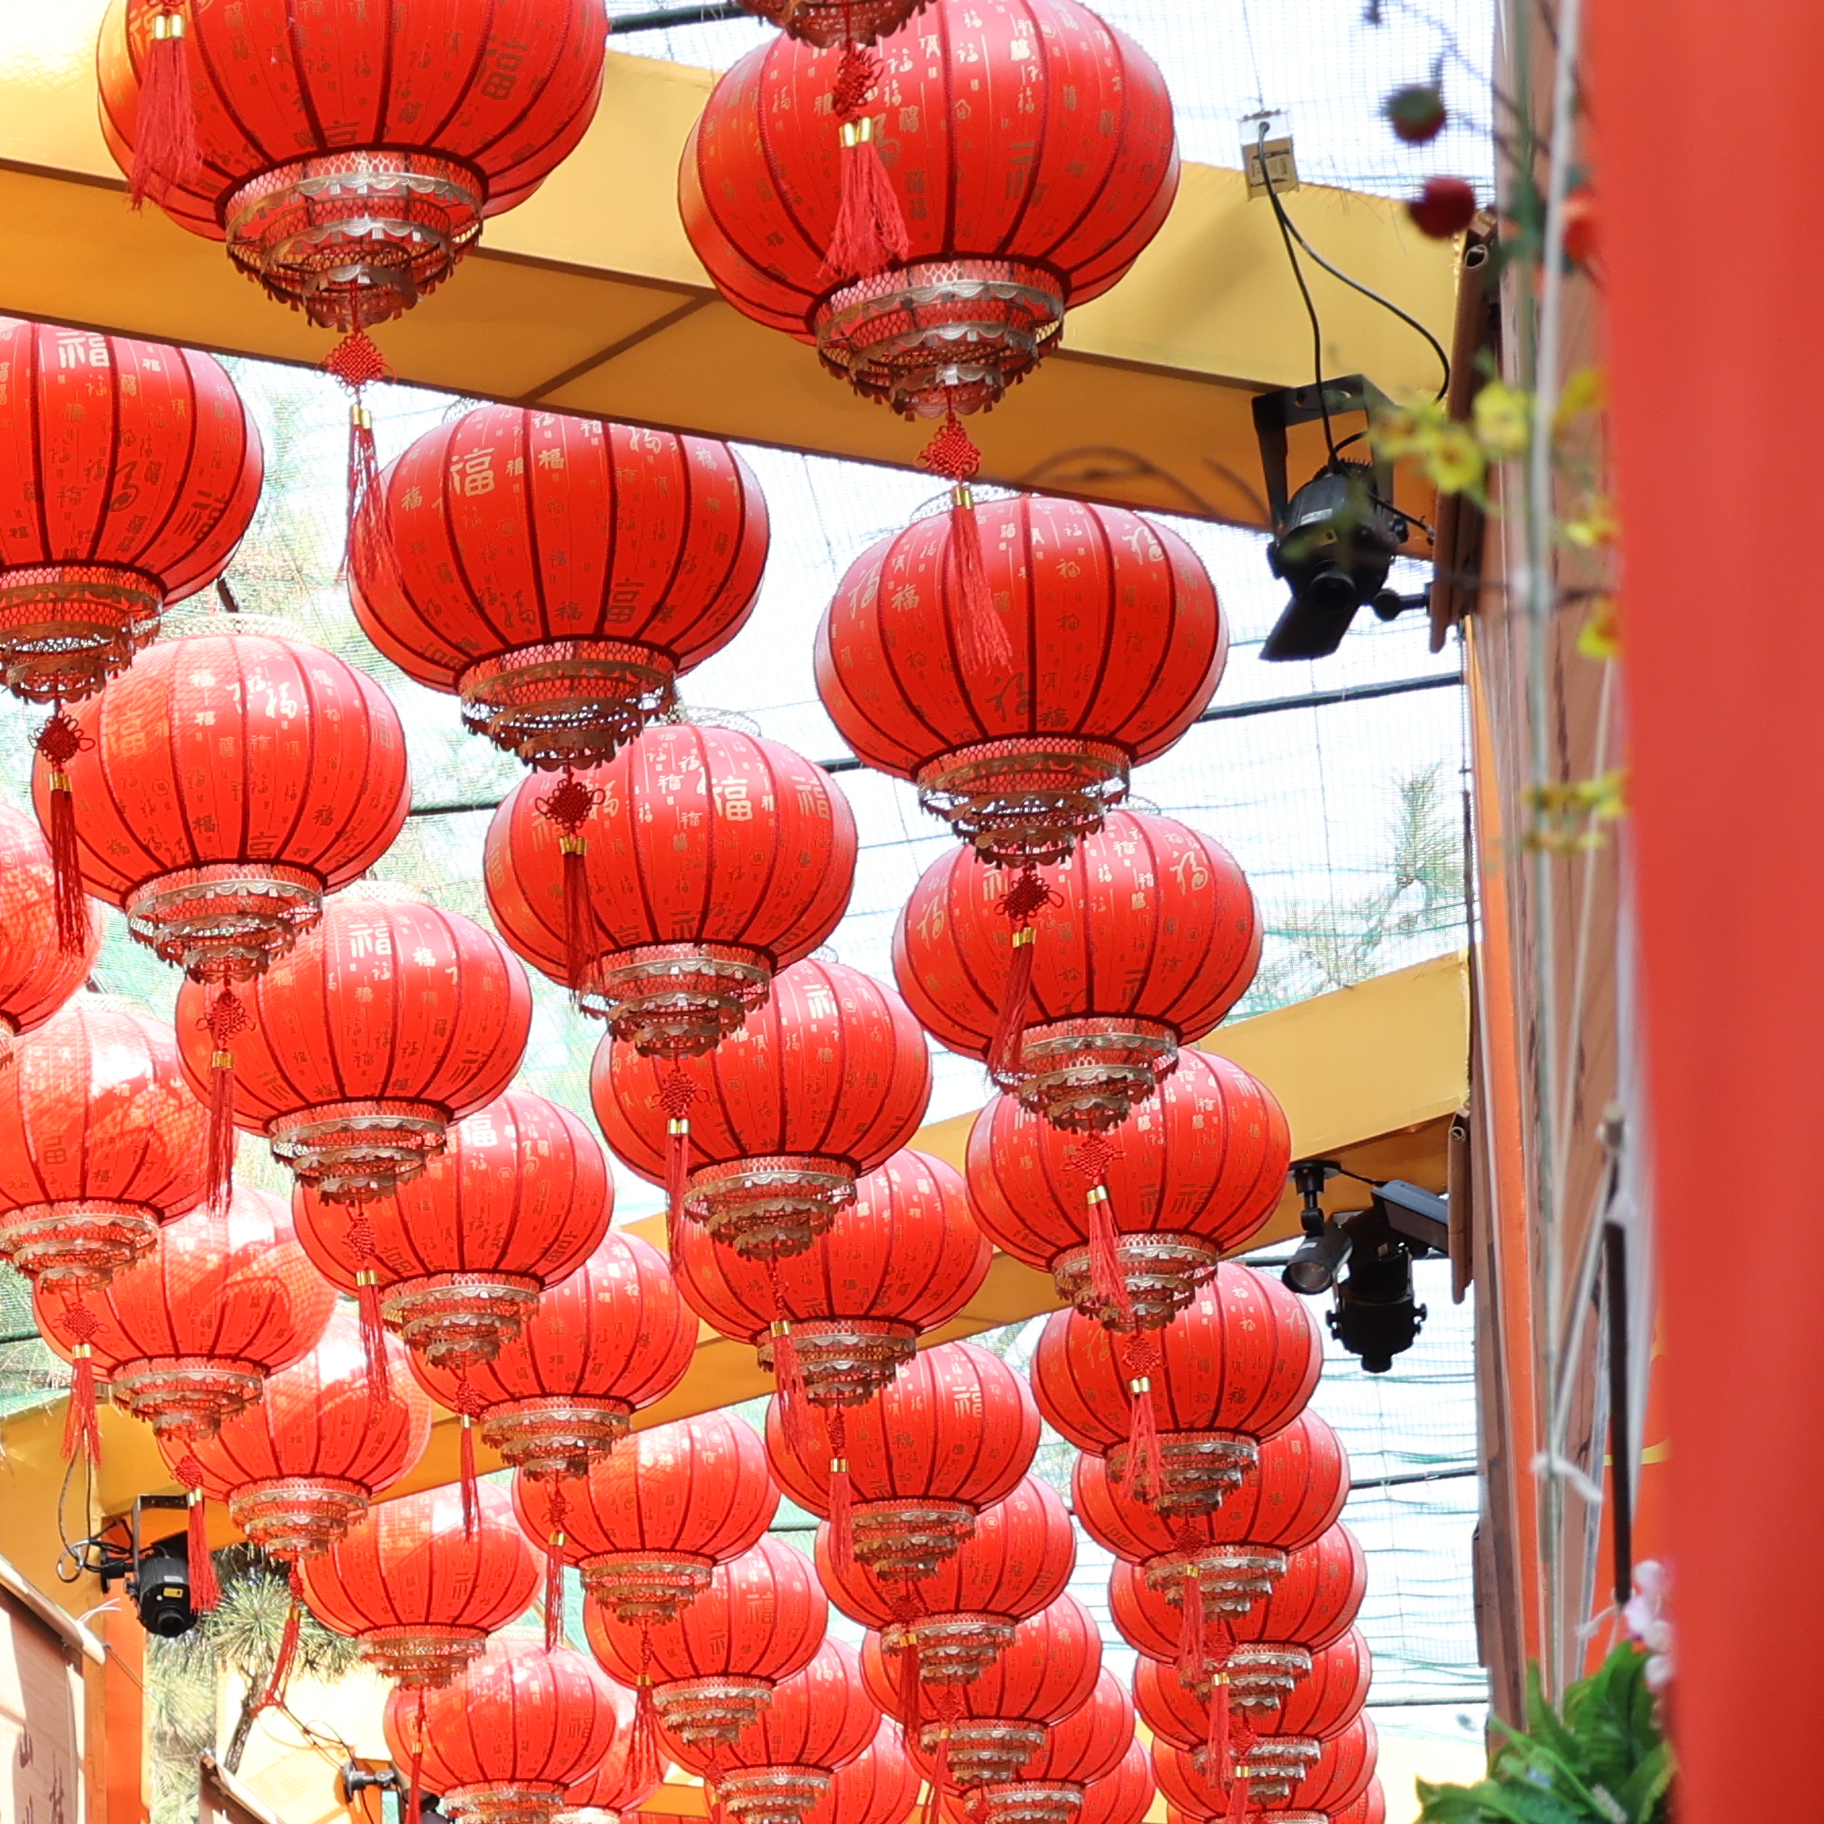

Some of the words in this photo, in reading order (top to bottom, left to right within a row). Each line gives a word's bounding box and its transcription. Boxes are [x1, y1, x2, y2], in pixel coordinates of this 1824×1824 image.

[56, 332, 111, 369] 福
[449, 447, 496, 497] 福
[539, 449, 565, 469] 福
[1126, 524, 1163, 564] 福
[891, 585, 919, 611] 福
[267, 683, 296, 718] 福
[106, 711, 147, 755] 福
[658, 774, 683, 794] 福
[716, 778, 753, 822] 福
[791, 776, 829, 819] 福
[1113, 839, 1138, 858] 福
[1170, 852, 1209, 894] 福
[350, 924, 392, 957] 福
[413, 947, 435, 966] 福
[464, 1116, 497, 1147] 福
[954, 1384, 982, 1419] 福
